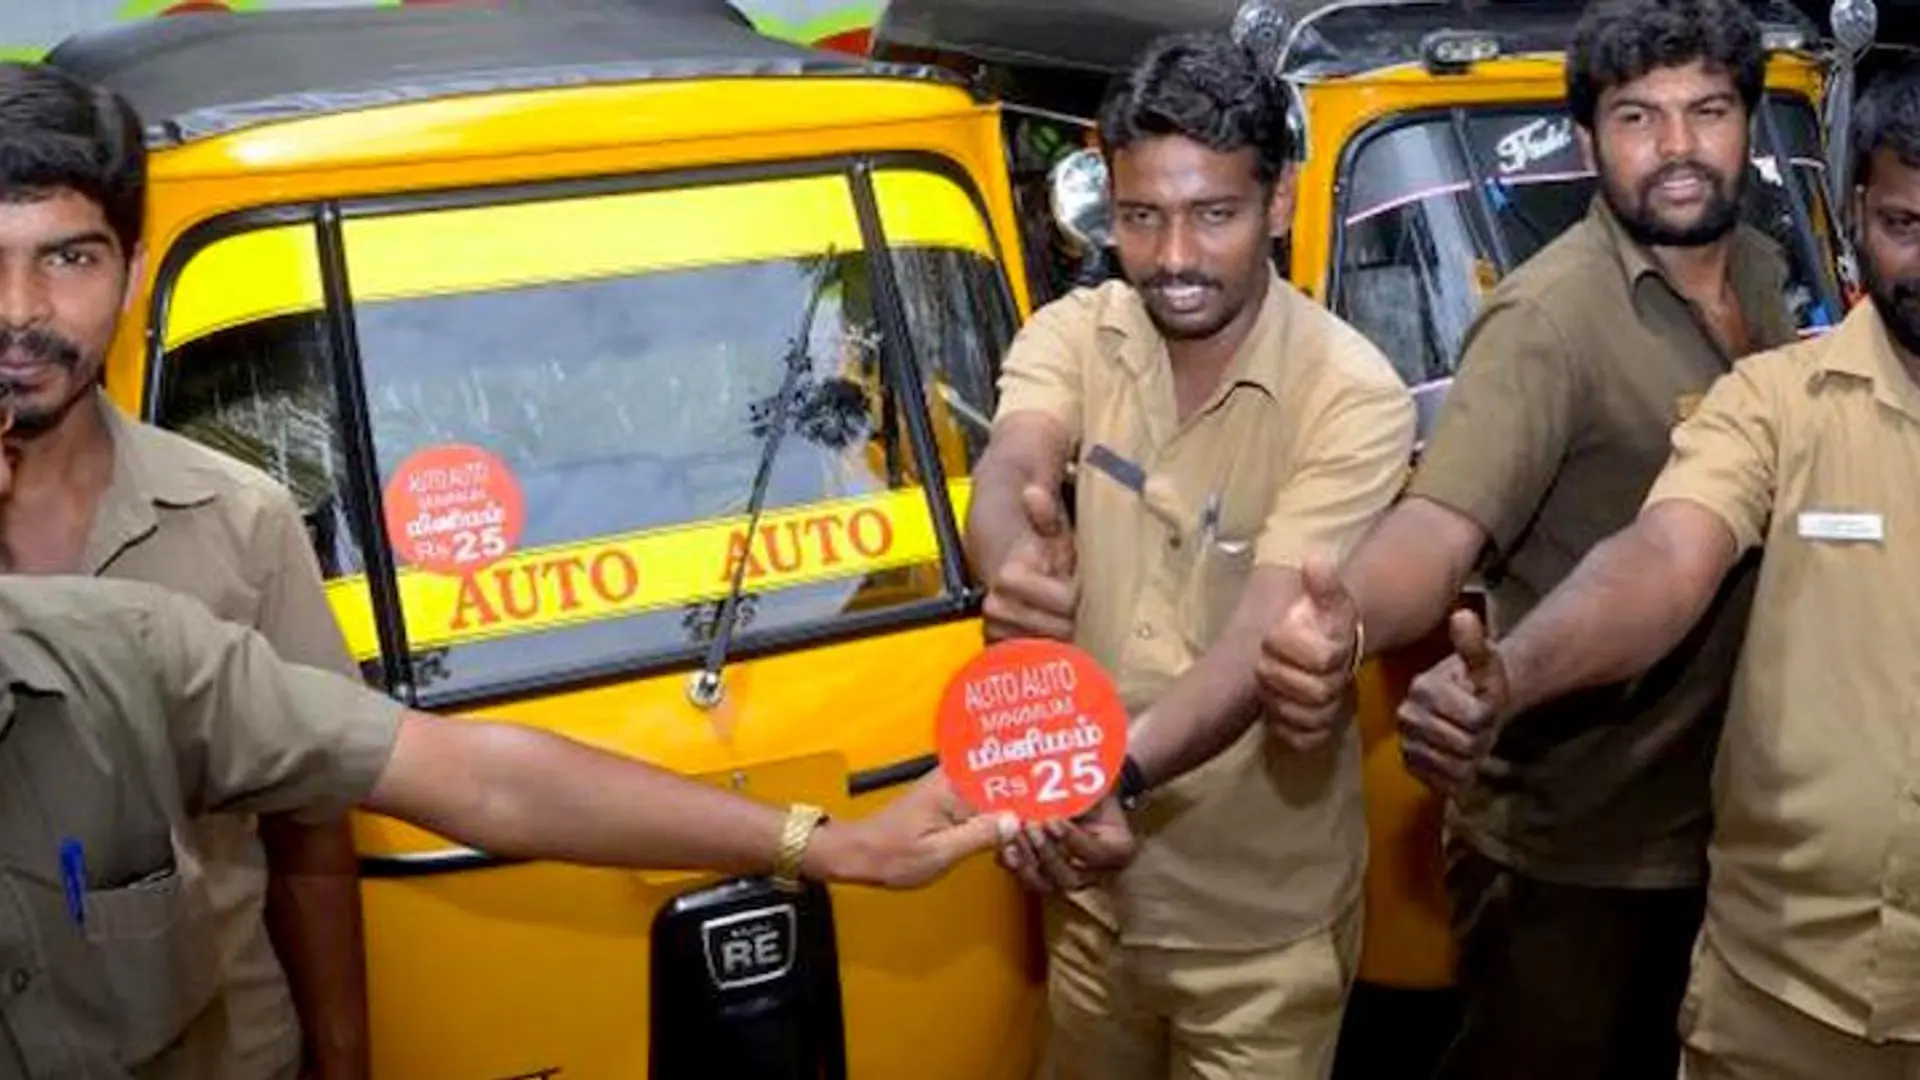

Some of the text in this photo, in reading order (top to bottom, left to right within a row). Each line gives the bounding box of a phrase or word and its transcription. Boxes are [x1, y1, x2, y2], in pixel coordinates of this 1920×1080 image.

[450, 506, 894, 630] AUTO AUTO
[453, 528, 506, 564] 25
[965, 659, 1077, 711] AUTO AUTO
[984, 752, 1106, 803] Rs 25
[722, 930, 783, 974] RE
